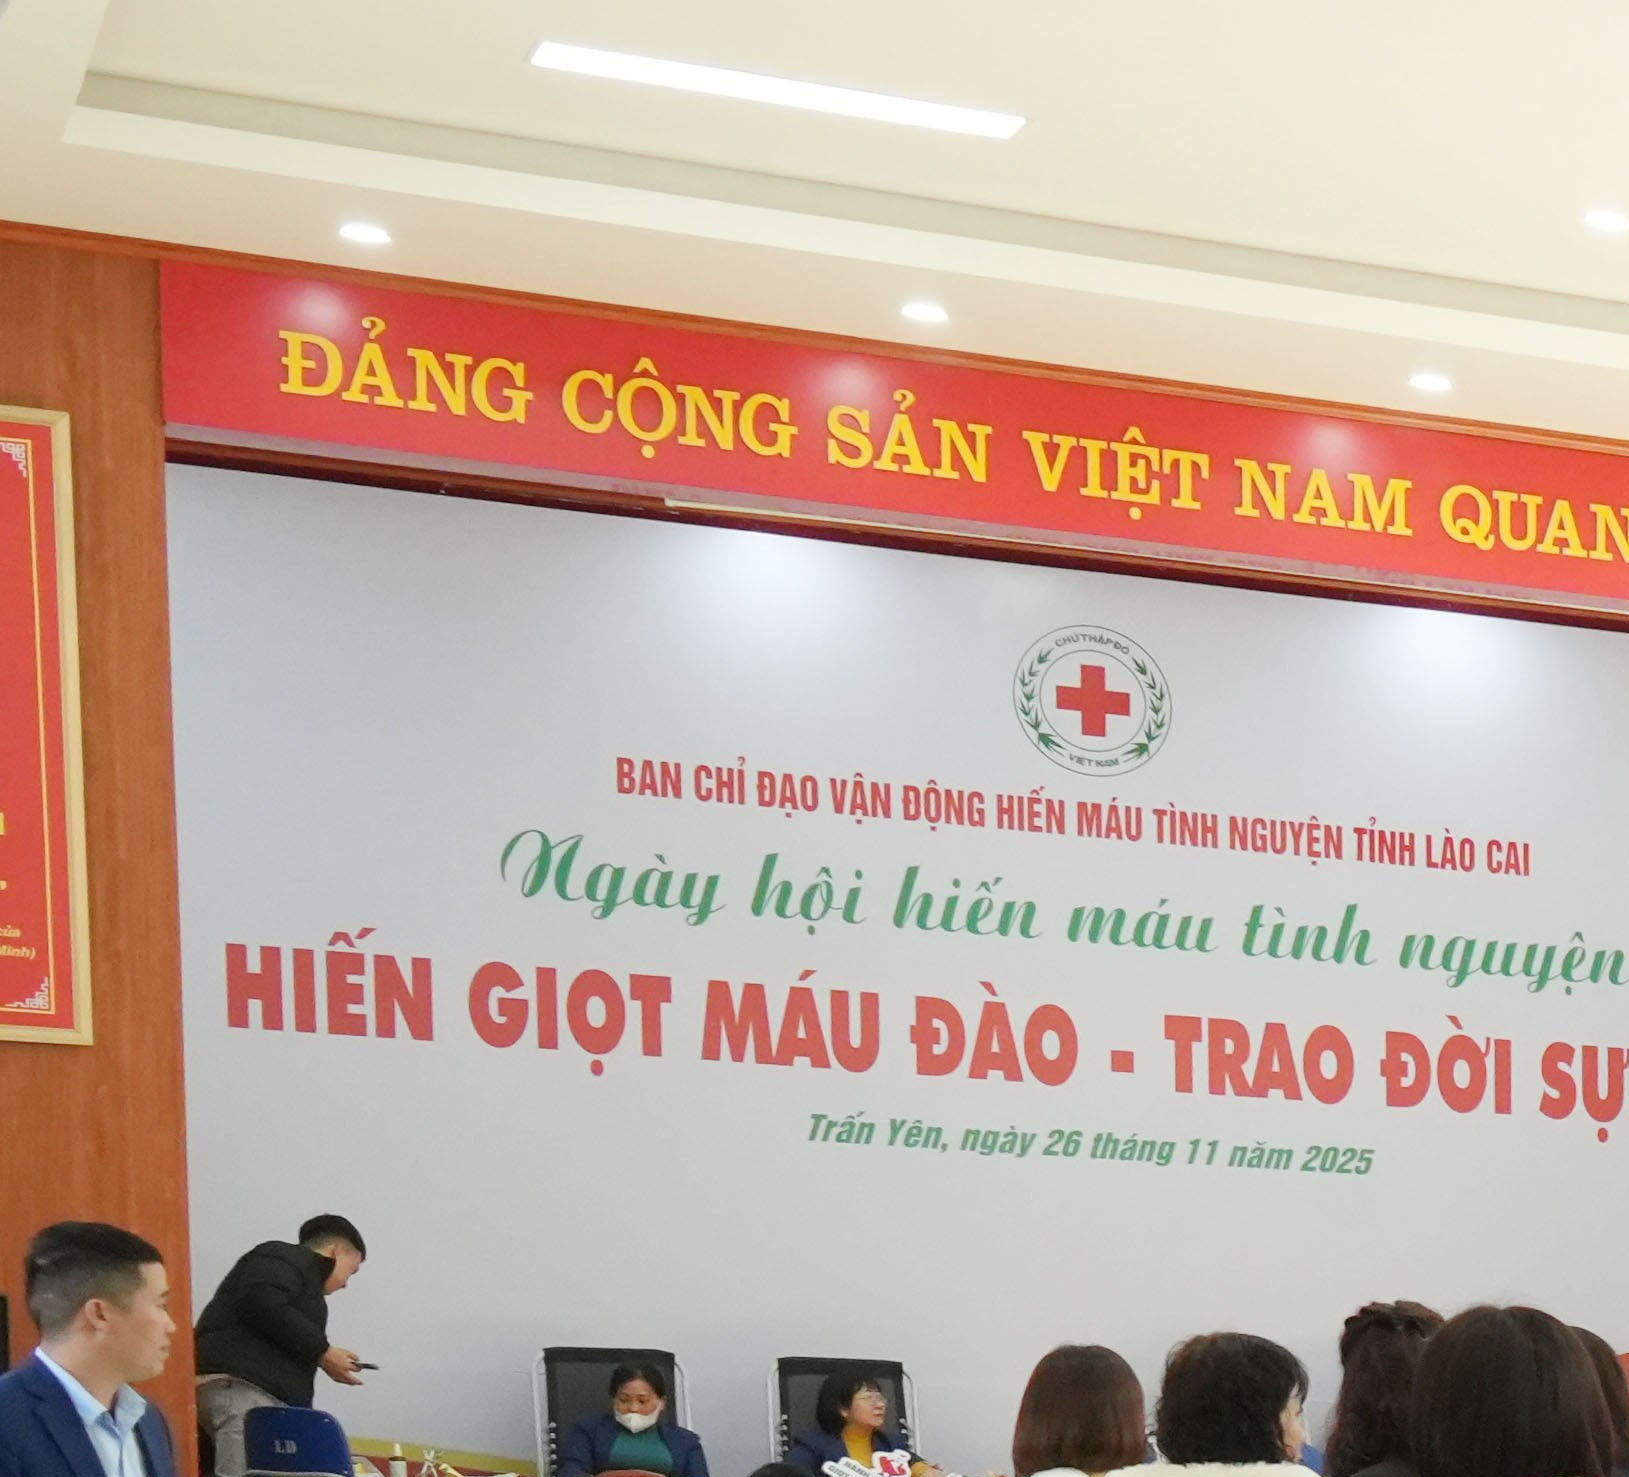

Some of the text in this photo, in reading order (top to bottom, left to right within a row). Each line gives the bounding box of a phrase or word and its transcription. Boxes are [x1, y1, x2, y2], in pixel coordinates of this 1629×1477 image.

[279, 315, 533, 422] ĐẢNG
[562, 356, 799, 459] CỘNG
[826, 389, 993, 483] SẢN
[1021, 425, 1211, 520] VIỆT
[1234, 455, 1414, 538] NAM
[616, 756, 1532, 877] BAN CHỈ ĐẠO VẬN ĐỘNG HIẾN MÁU TÌNH NGUYỆN TỈNH LÀO CAI
[500, 831, 724, 928] Ngày
[750, 850, 865, 936] hội
[892, 863, 1042, 942] hiến
[1065, 897, 1216, 956] máu
[1241, 902, 1375, 969] tình
[224, 926, 436, 1043] HIẾN
[467, 959, 674, 1077] GIỌT
[700, 968, 882, 1075] MÁU
[909, 979, 1080, 1088] ĐÀO
[1109, 1048, 1136, 1074] -
[1162, 1013, 1356, 1106] TRAO
[1379, 1014, 1514, 1116] ĐỜI
[807, 1111, 1376, 1177] Trấn Yên, ngày 26 tháng 11 năm 2025
